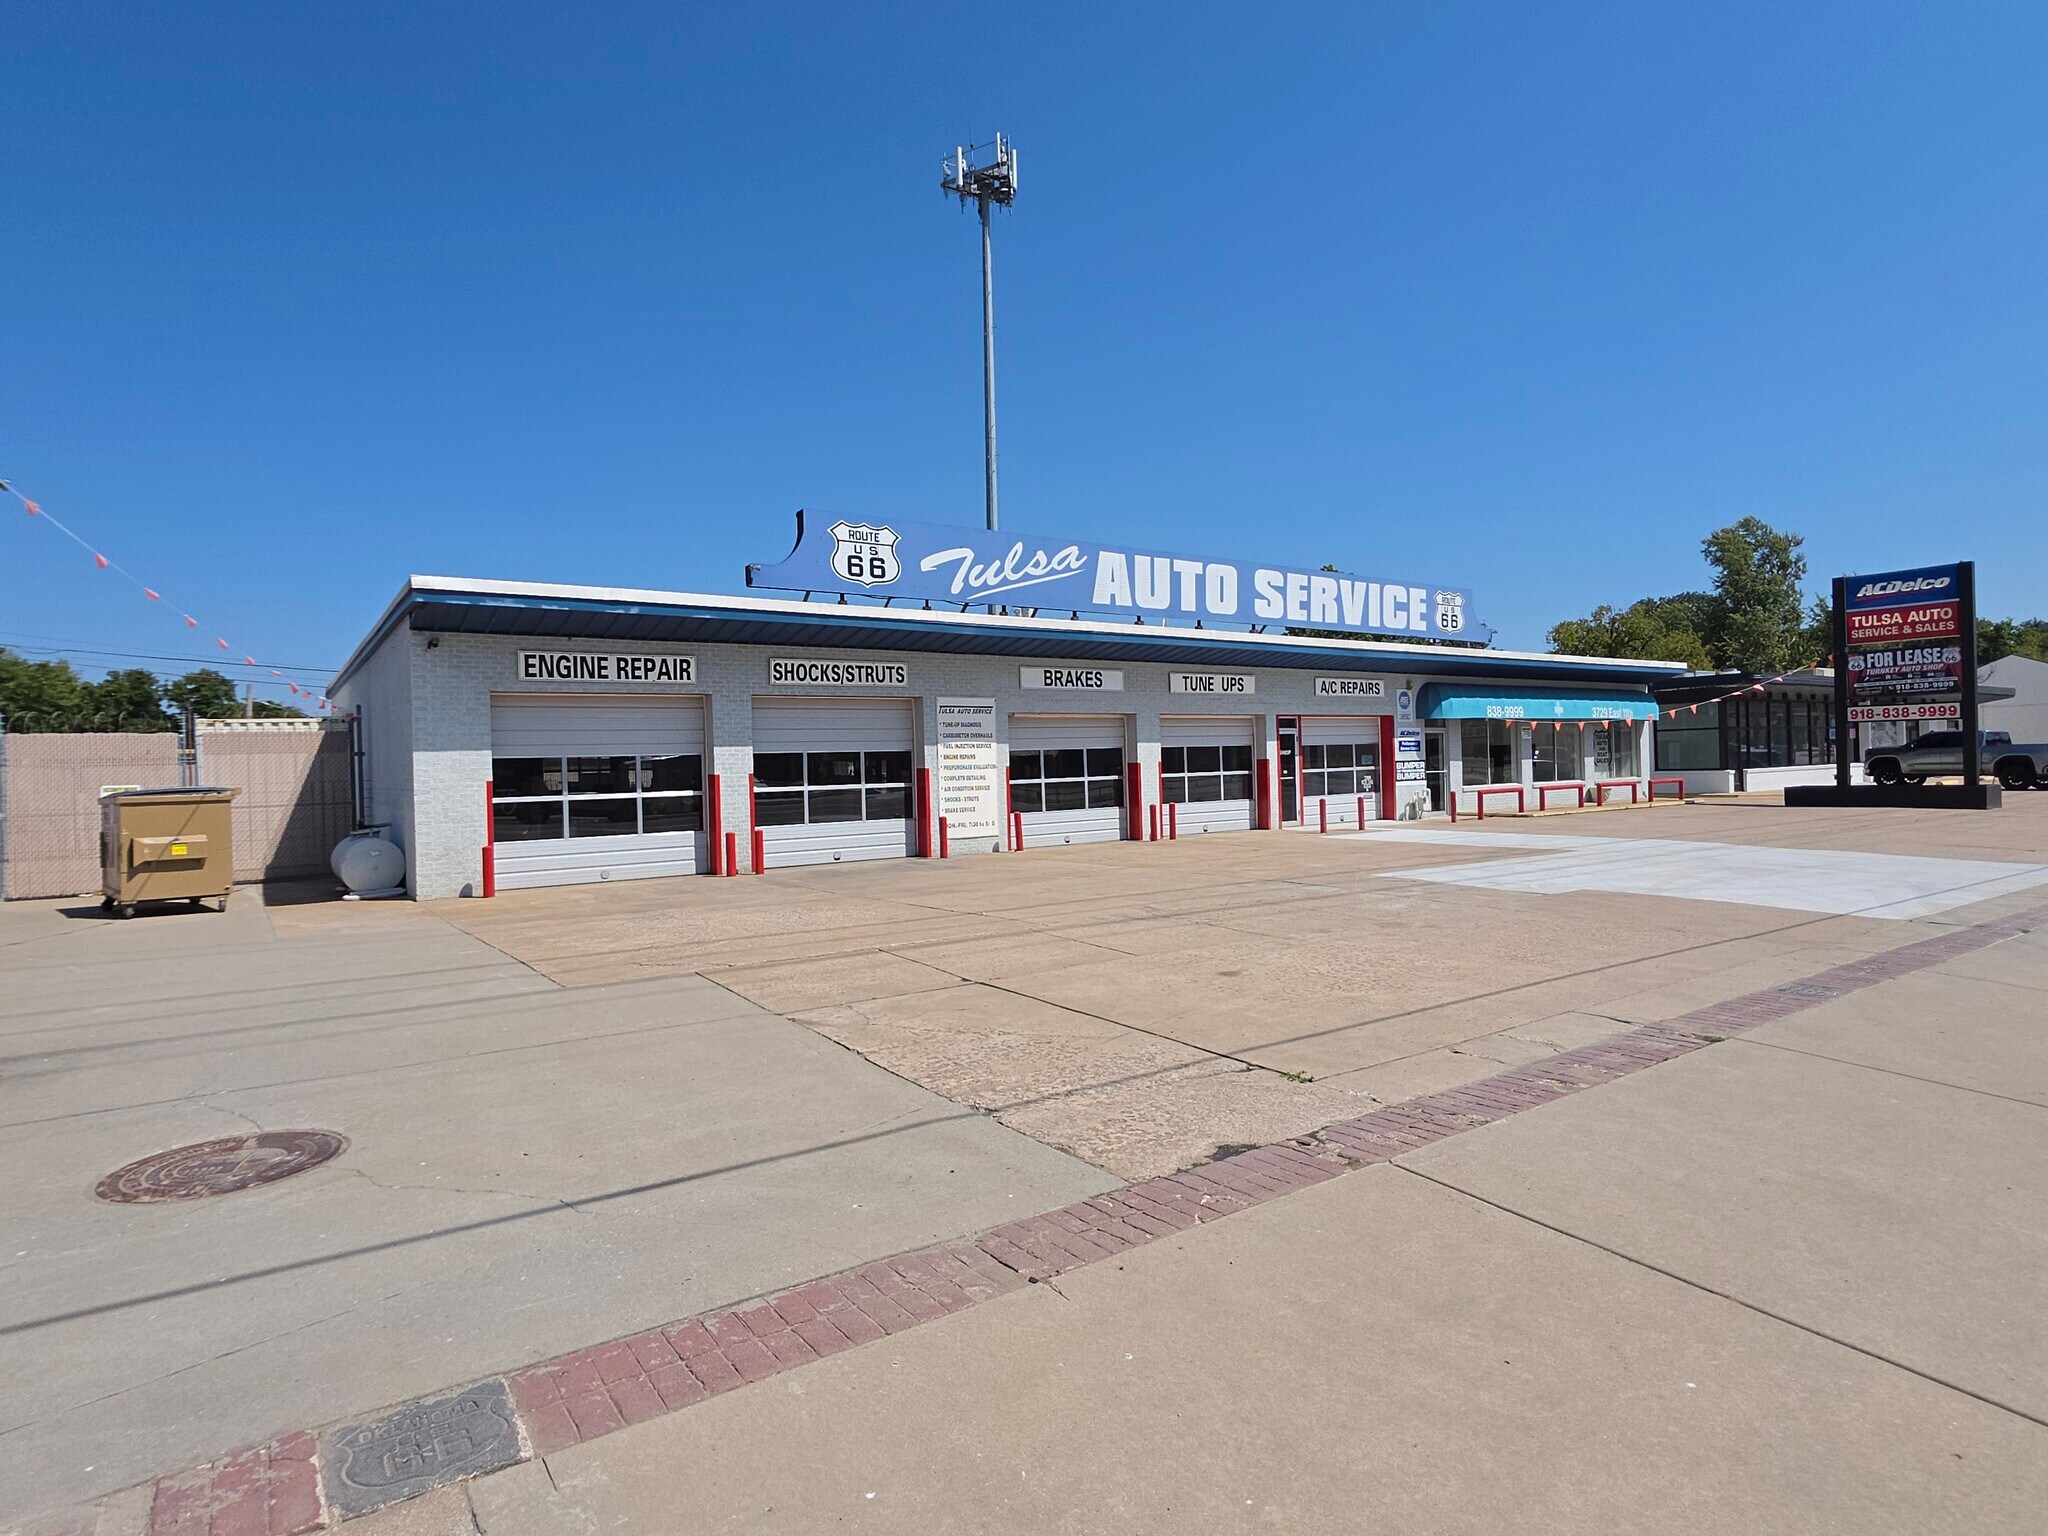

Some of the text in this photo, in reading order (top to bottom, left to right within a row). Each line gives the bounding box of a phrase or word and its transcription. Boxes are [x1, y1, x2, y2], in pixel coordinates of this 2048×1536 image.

[848, 529, 880, 542] ROUTE
[847, 555, 886, 579] 66
[920, 541, 1427, 632] Tulsa AUTO SERVICE
[1856, 577, 1950, 597] ACDelco
[1441, 596, 1456, 605] ROUTE
[1441, 613, 1458, 629] 66
[1852, 607, 1953, 627] TULSA AUTO
[1851, 620, 1955, 638] SERVICE & SALES
[1866, 648, 1941, 668] FOR LEASE
[1945, 654, 1957, 662] 66
[524, 653, 692, 681] ENGINE REPAIR
[772, 661, 906, 685] SHOCKS/STRUTS
[1866, 666, 1900, 675] TURNKEY
[1901, 665, 1920, 673] AUTO
[1043, 669, 1103, 688] BRAKES
[1182, 675, 1244, 692] TUNE UPS
[1320, 680, 1381, 695] A/C REPAIRS
[1486, 705, 1524, 718] 838-9999
[1591, 707, 1609, 718] 3729
[1609, 708, 1621, 719] East
[1850, 705, 1958, 719] 918-838-9999
[1396, 761, 1425, 769] BUMPER
[1396, 772, 1426, 780] BUMPER
